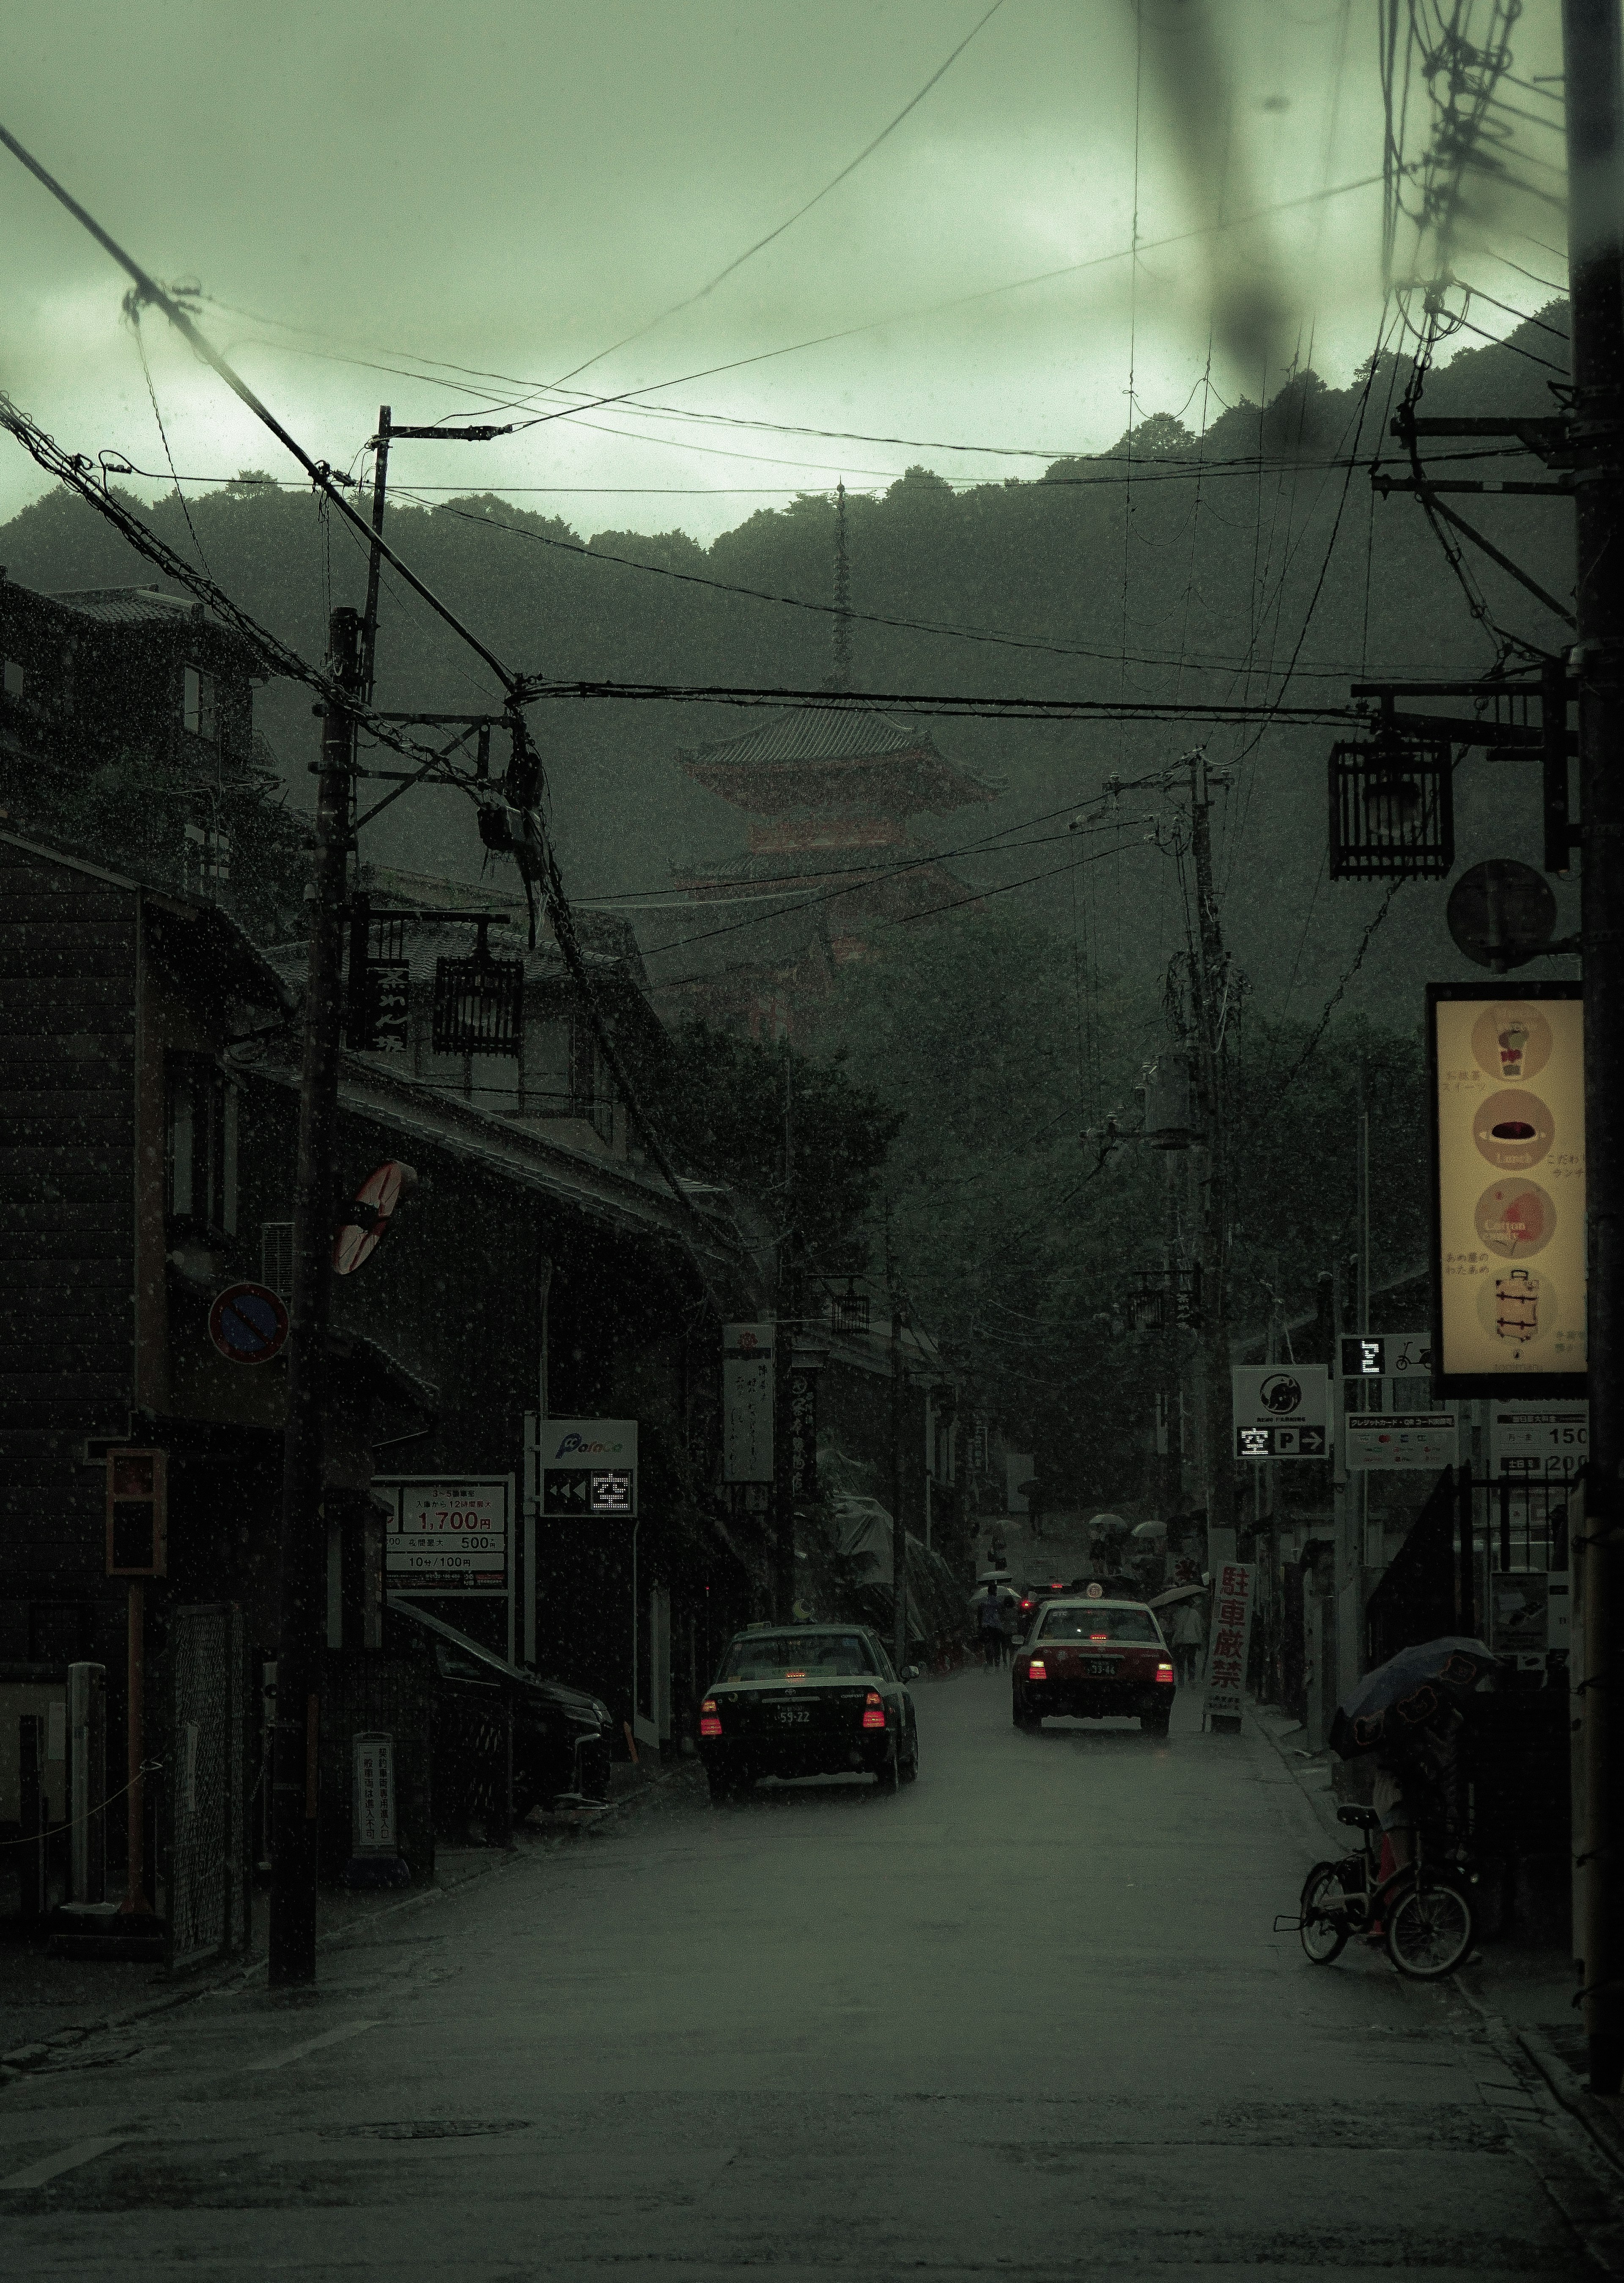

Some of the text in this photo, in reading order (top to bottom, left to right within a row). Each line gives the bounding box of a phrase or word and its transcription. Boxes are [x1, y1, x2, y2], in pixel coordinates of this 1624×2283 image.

[373, 970, 410, 1052] 茶わん坂
[1446, 1265, 1490, 1275] わたあめ
[1241, 1428, 1268, 1454] 空
[593, 1473, 628, 1508] 空
[419, 1512, 491, 1530] 1,700円
[409, 1539, 444, 1548] 夜間最大
[409, 1557, 471, 1567] 10分/100円
[1210, 1566, 1250, 1690] 駐車厳禁
